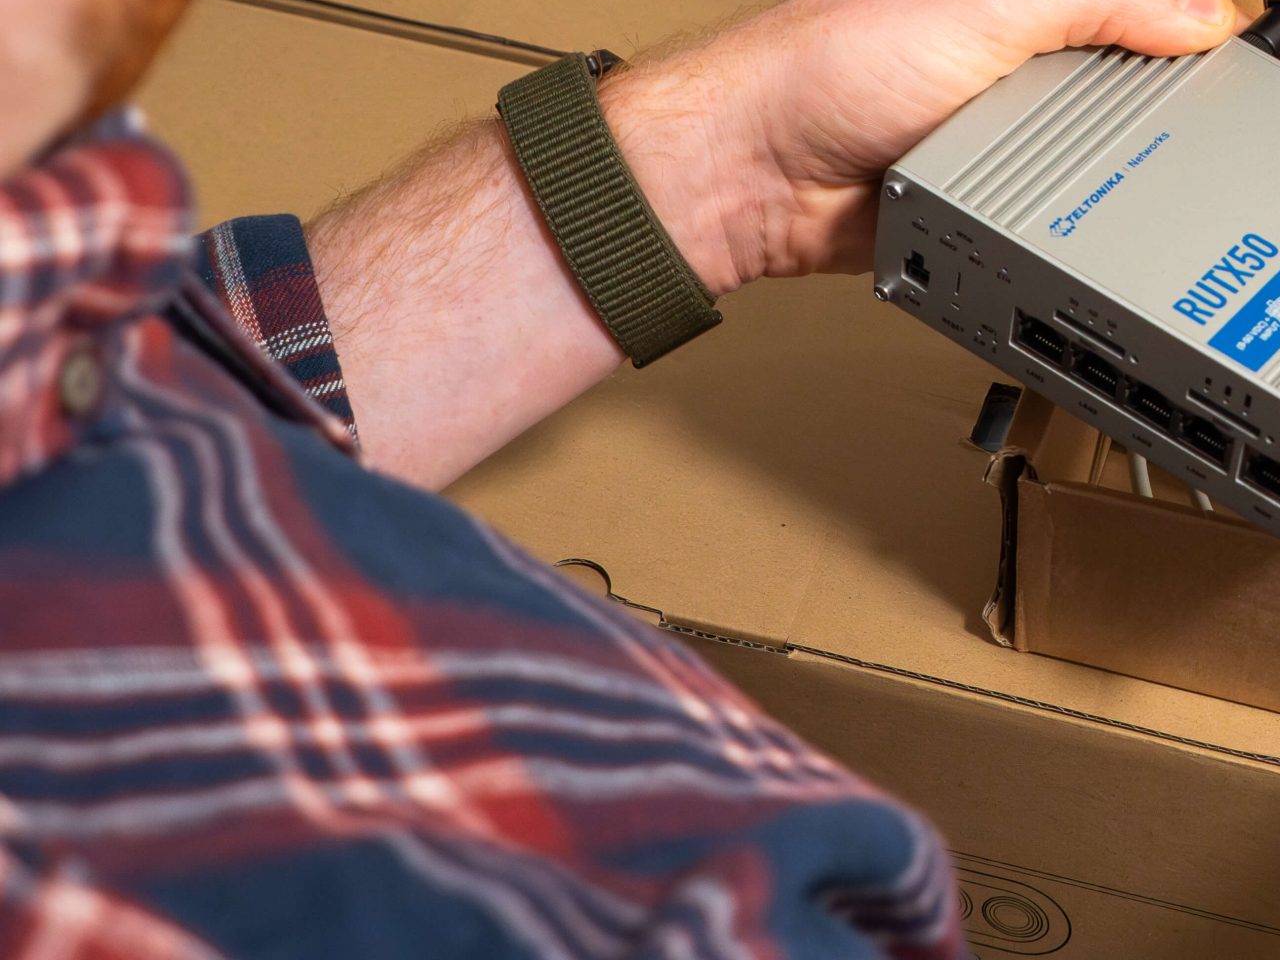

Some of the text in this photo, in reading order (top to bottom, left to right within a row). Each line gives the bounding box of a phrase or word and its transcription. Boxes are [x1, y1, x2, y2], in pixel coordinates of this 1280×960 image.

[1065, 131, 1171, 224] TELTONIKA Networks
[1172, 233, 1279, 326] RUTX50
